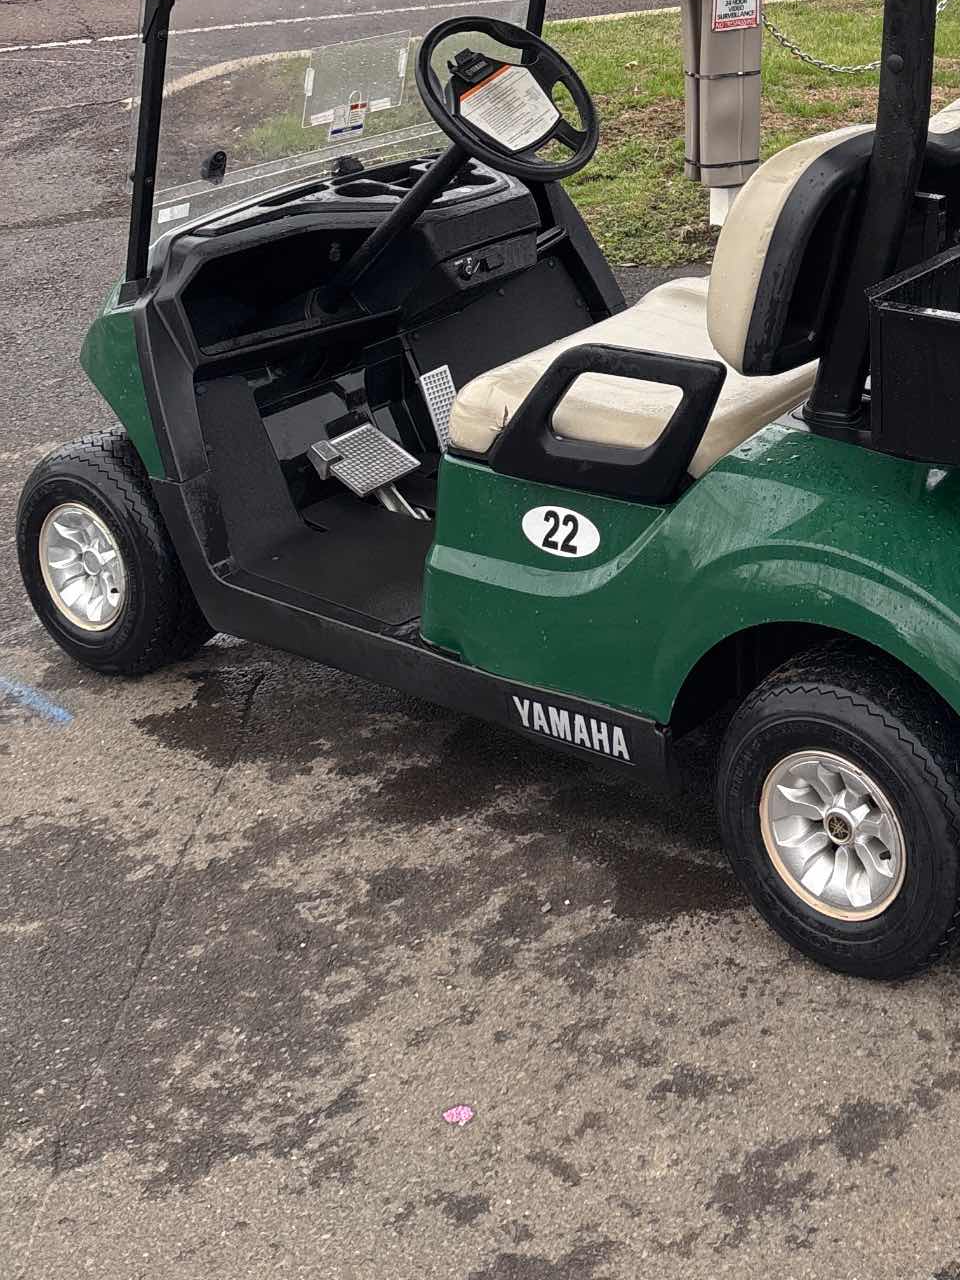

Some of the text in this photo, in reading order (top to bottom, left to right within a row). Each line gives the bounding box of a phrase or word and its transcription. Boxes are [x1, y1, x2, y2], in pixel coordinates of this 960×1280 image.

[717, 10, 755, 20] SURVEILLANCE
[728, 4, 745, 12] VIDEO
[542, 509, 579, 555] 22
[512, 695, 631, 761] YAMAHA
